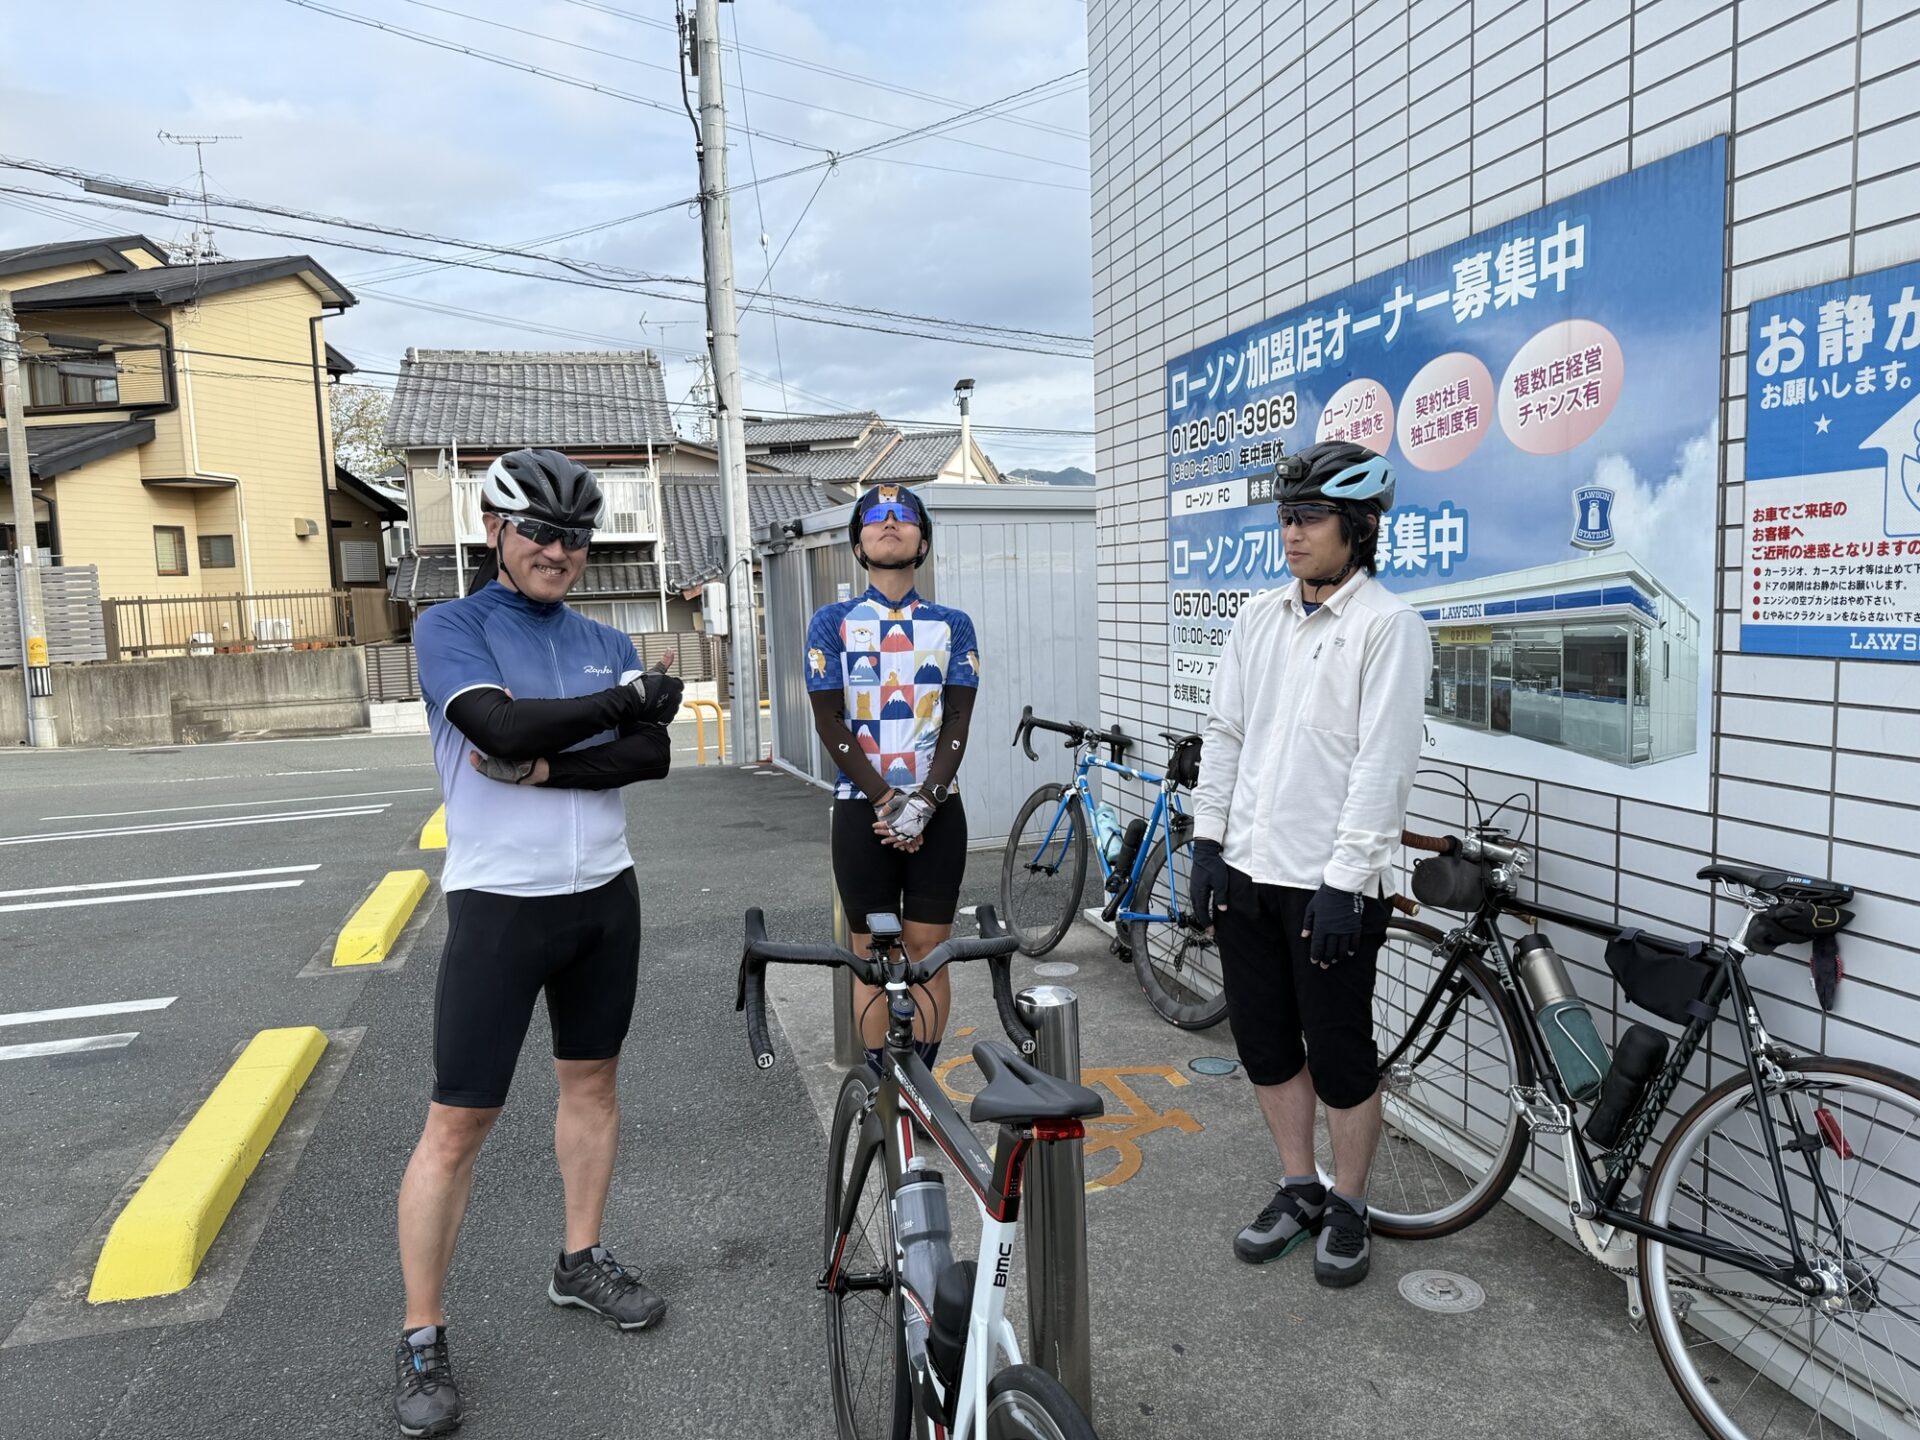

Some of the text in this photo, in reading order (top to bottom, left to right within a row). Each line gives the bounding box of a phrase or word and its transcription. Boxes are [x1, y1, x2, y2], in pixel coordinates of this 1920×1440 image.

[1172, 219, 1585, 411] ローソン加盟店オーナー募集中
[1513, 345, 1602, 399] 複数店経営
[1760, 360, 1912, 410] お願いします。
[1324, 388, 1376, 426] ローソンが
[1415, 379, 1471, 419] 契約社員
[1518, 380, 1601, 426] チャンス有
[1171, 395, 1296, 454] 0120-01-3963
[1410, 405, 1479, 448] 独立制度有
[1238, 438, 1284, 469] 年中無休
[1185, 487, 1230, 509] ローソン FC
[1250, 479, 1271, 500] 検索
[1578, 490, 1611, 502] LAWSON
[1752, 501, 1848, 523] お車でご来店の
[1173, 528, 1290, 575] ローソンアル
[1752, 525, 1805, 542] お客様へ
[1441, 603, 1482, 620] LAWSON
[1849, 632, 1920, 652] LAWS
[1177, 658, 1204, 675] ローソン
[1487, 941, 1517, 991] AFFINITY
[760, 1055, 771, 1066] 3T
[993, 1242, 1012, 1287] BMC
